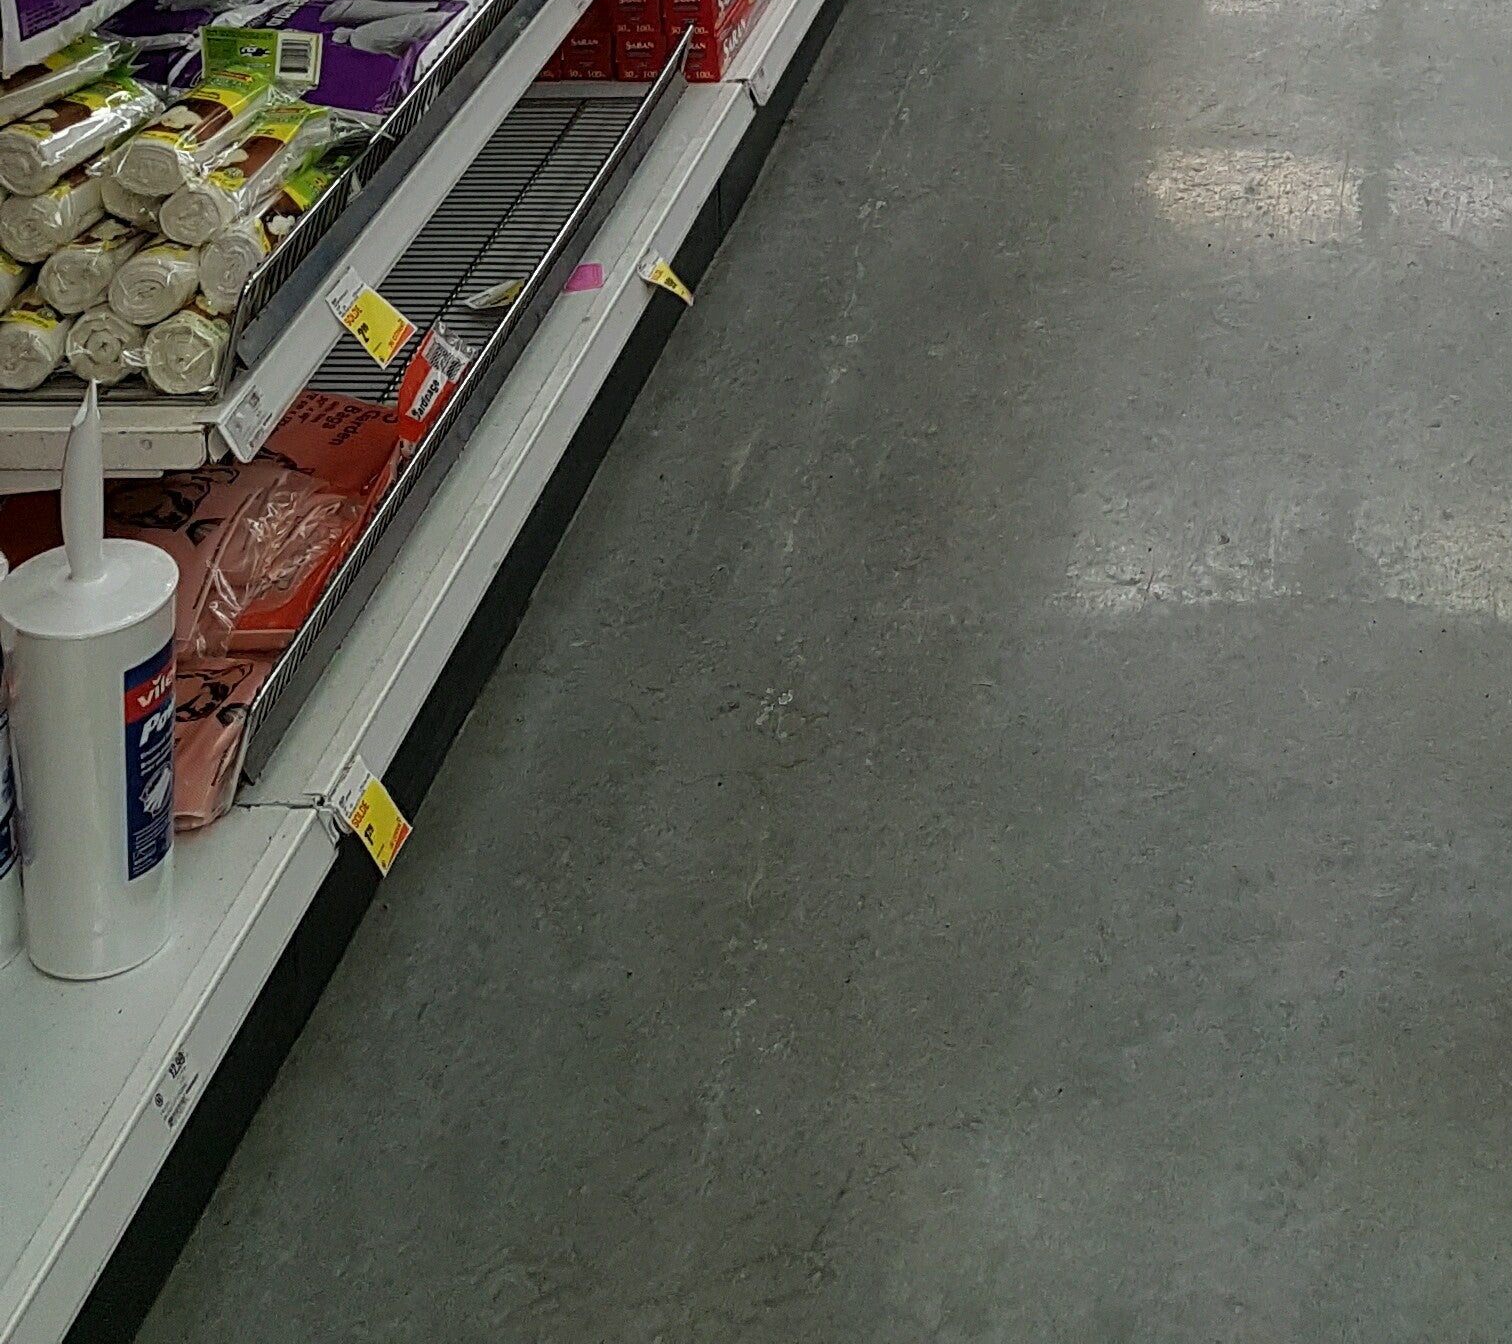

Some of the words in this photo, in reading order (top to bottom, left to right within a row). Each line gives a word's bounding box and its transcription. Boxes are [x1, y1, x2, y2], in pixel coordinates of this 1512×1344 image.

[571, 37, 600, 48] SARAN
[626, 40, 655, 51] SARAN
[722, 18, 747, 62] SARAN
[350, 798, 371, 830] SOLDE
